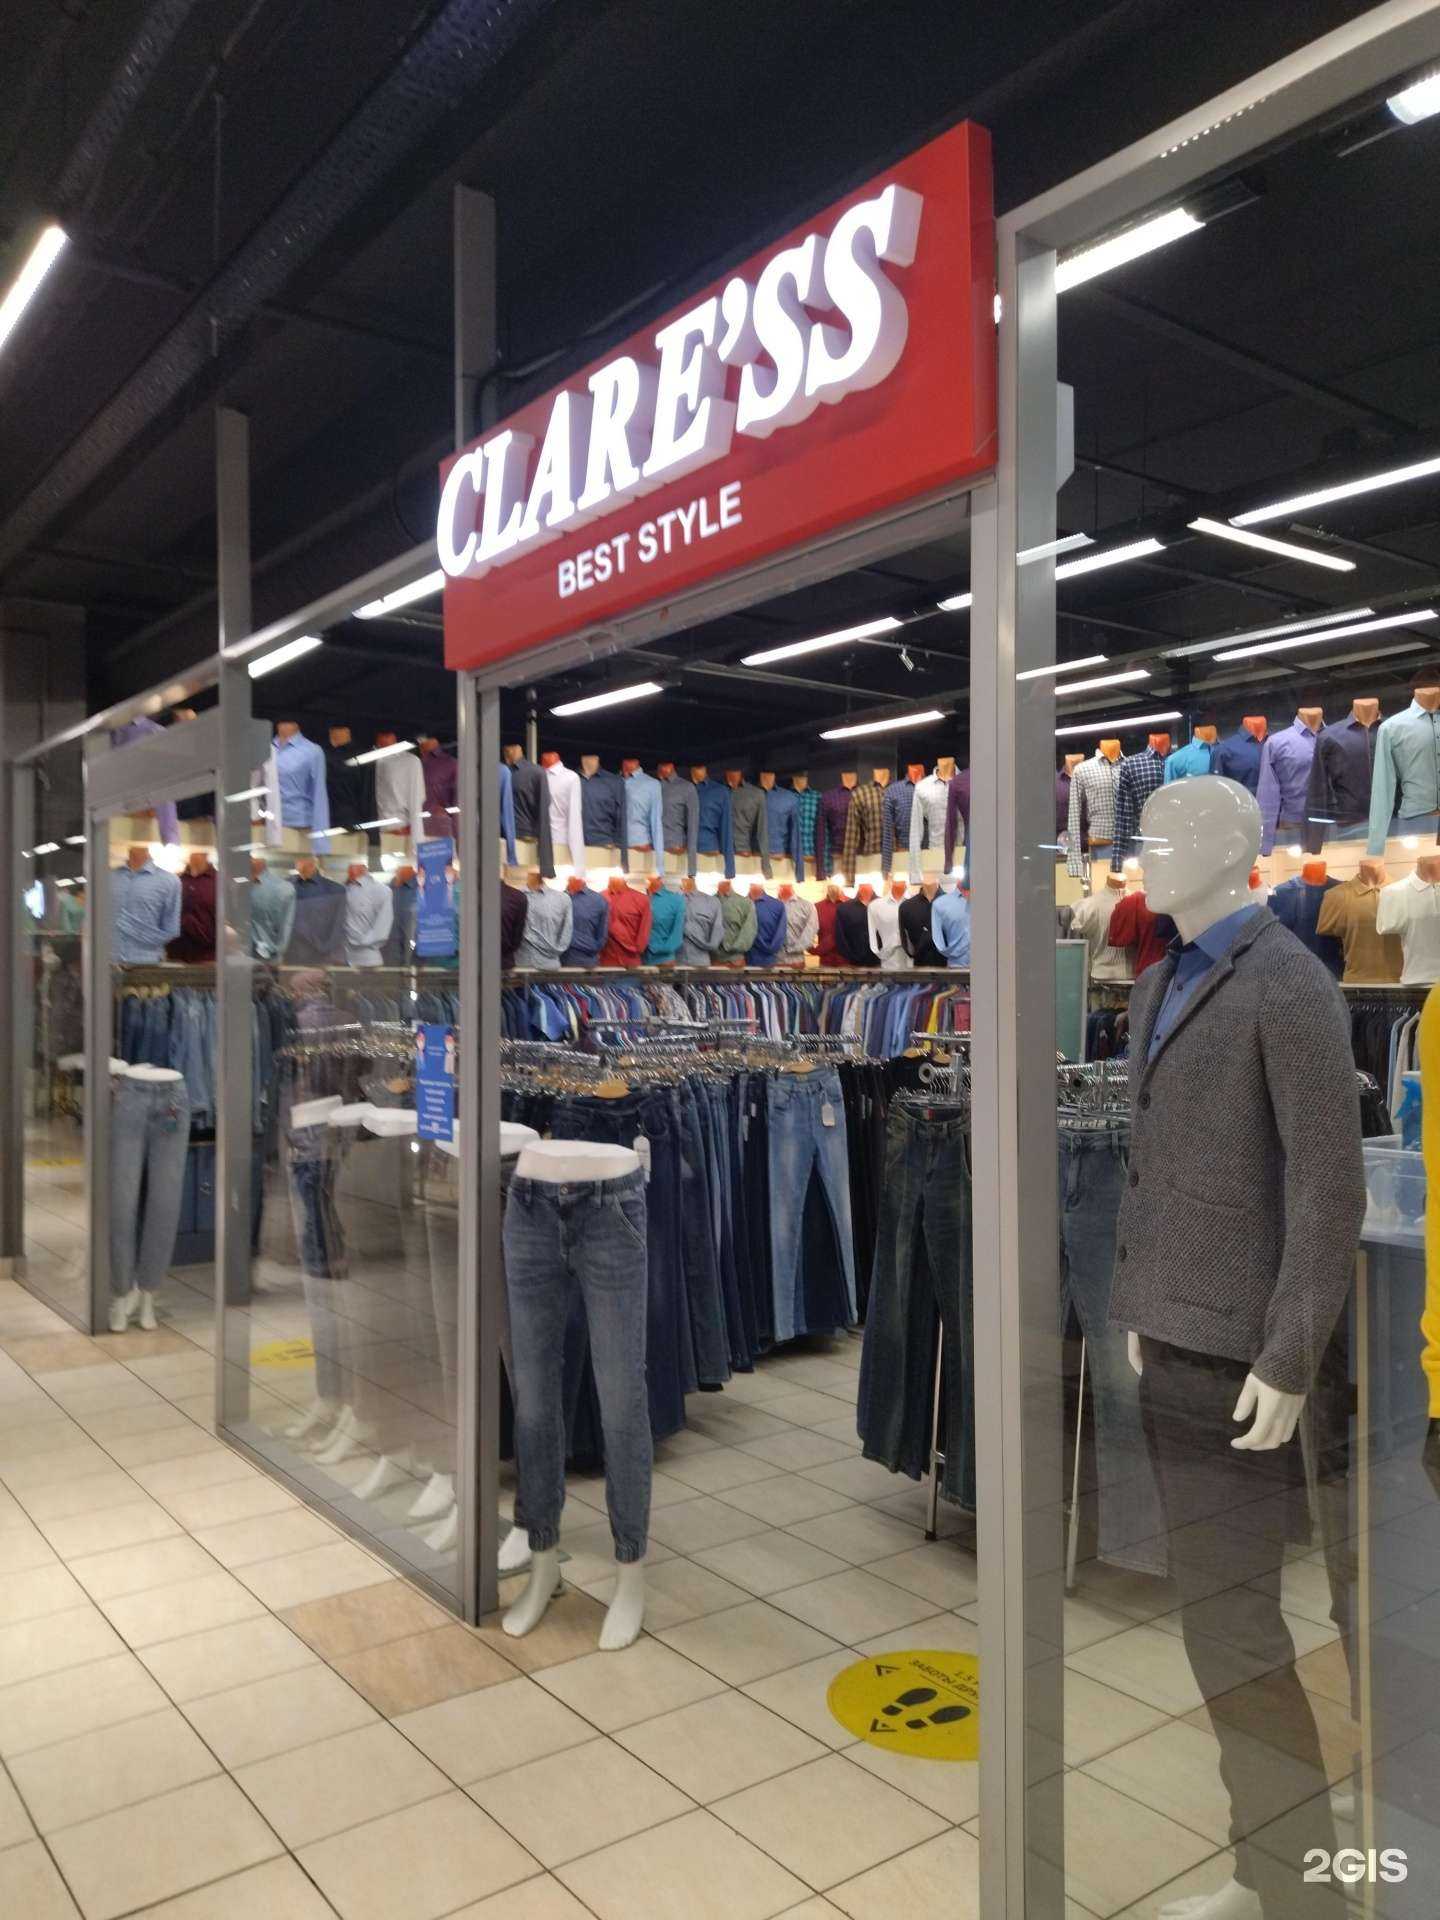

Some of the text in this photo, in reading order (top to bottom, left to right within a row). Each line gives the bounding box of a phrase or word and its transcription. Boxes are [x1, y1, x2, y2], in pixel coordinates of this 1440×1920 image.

[437, 183, 922, 580] CLARE'SS
[557, 481, 743, 600] BEST STYLE
